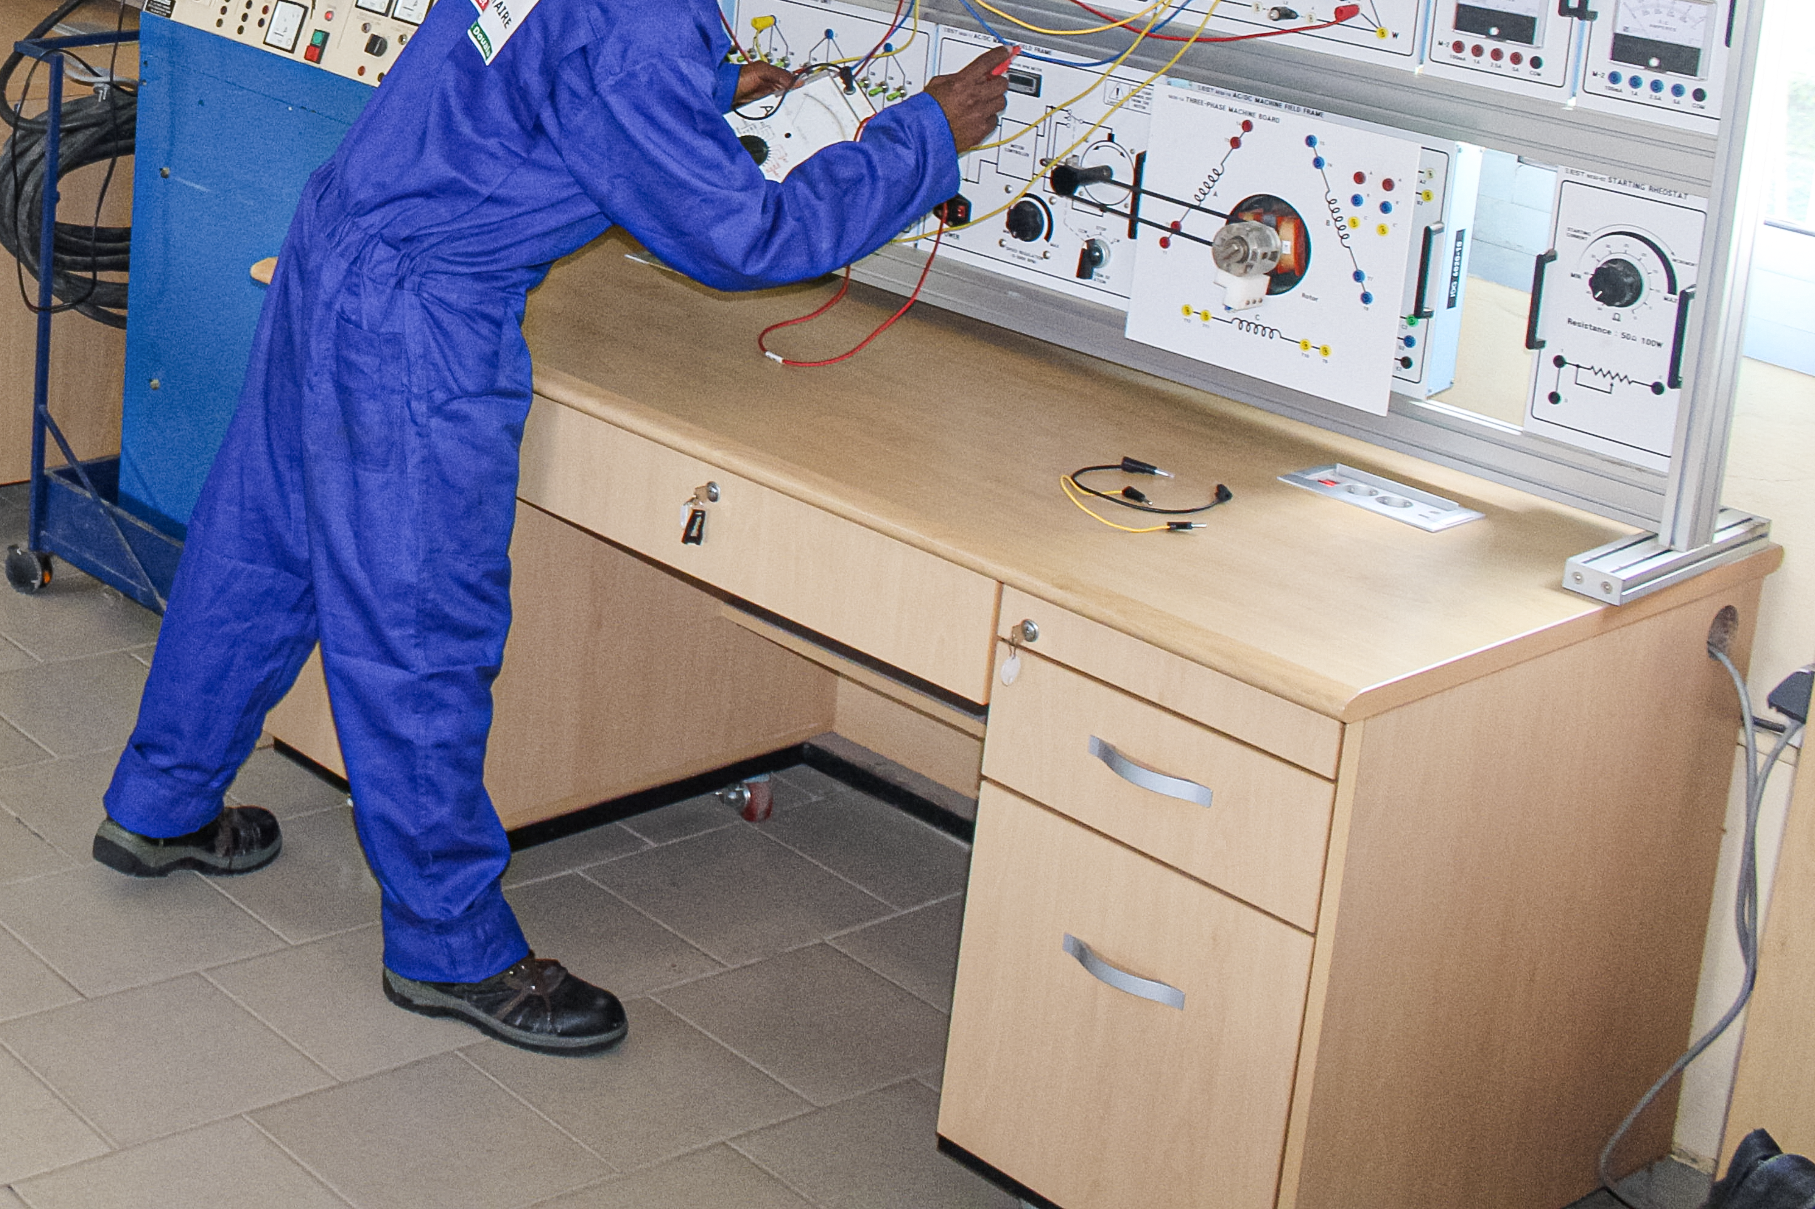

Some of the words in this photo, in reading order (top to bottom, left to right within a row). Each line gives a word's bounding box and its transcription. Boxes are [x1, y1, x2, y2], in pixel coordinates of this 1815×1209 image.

[973, 34, 992, 42] AC/DC
[1185, 96, 1226, 112] THREE-PHASE
[1228, 106, 1257, 119] MACHINE
[1258, 113, 1280, 124] BOARD
[1232, 92, 1253, 102] AC/DC
[1254, 97, 1283, 109] MACHINE
[1284, 103, 1301, 113] FIELD
[1303, 108, 1324, 118] FRAME
[1608, 176, 1646, 191] STARTING
[1648, 185, 1689, 200] RHEOSTAT
[1301, 292, 1319, 302] Rotor
[1567, 318, 1612, 336] Resistance
[1641, 336, 1664, 349] 100W
